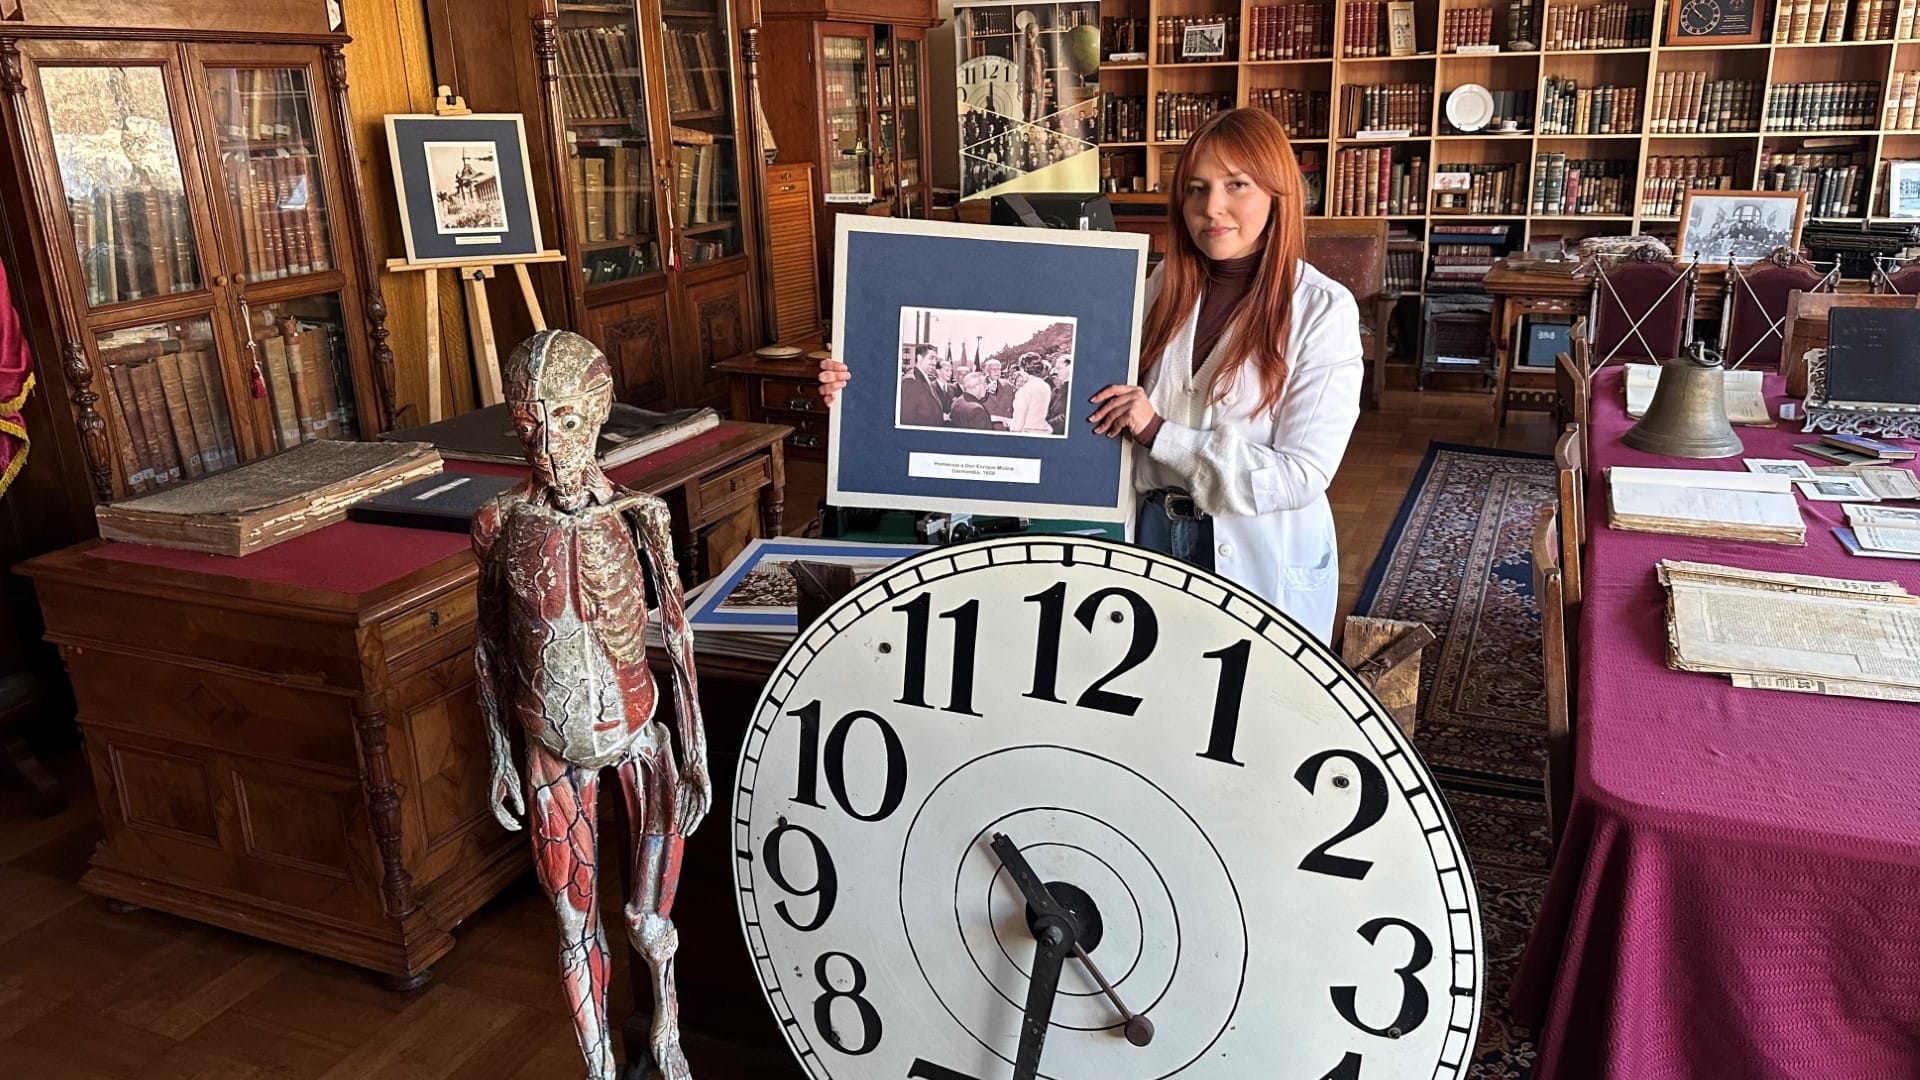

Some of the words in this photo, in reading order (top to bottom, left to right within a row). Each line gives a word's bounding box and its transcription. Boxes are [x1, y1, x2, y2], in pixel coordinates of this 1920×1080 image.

[963, 66, 976, 85] 11
[982, 61, 999, 80] 12
[1004, 65, 1010, 82] 1
[892, 592, 983, 717] 11
[1022, 582, 1159, 716] 12
[1196, 639, 1252, 767] 1
[787, 700, 908, 822] 10
[1294, 750, 1389, 880] 2
[763, 824, 838, 931] 9
[814, 952, 883, 1055] 8
[1330, 918, 1434, 1039] 3
